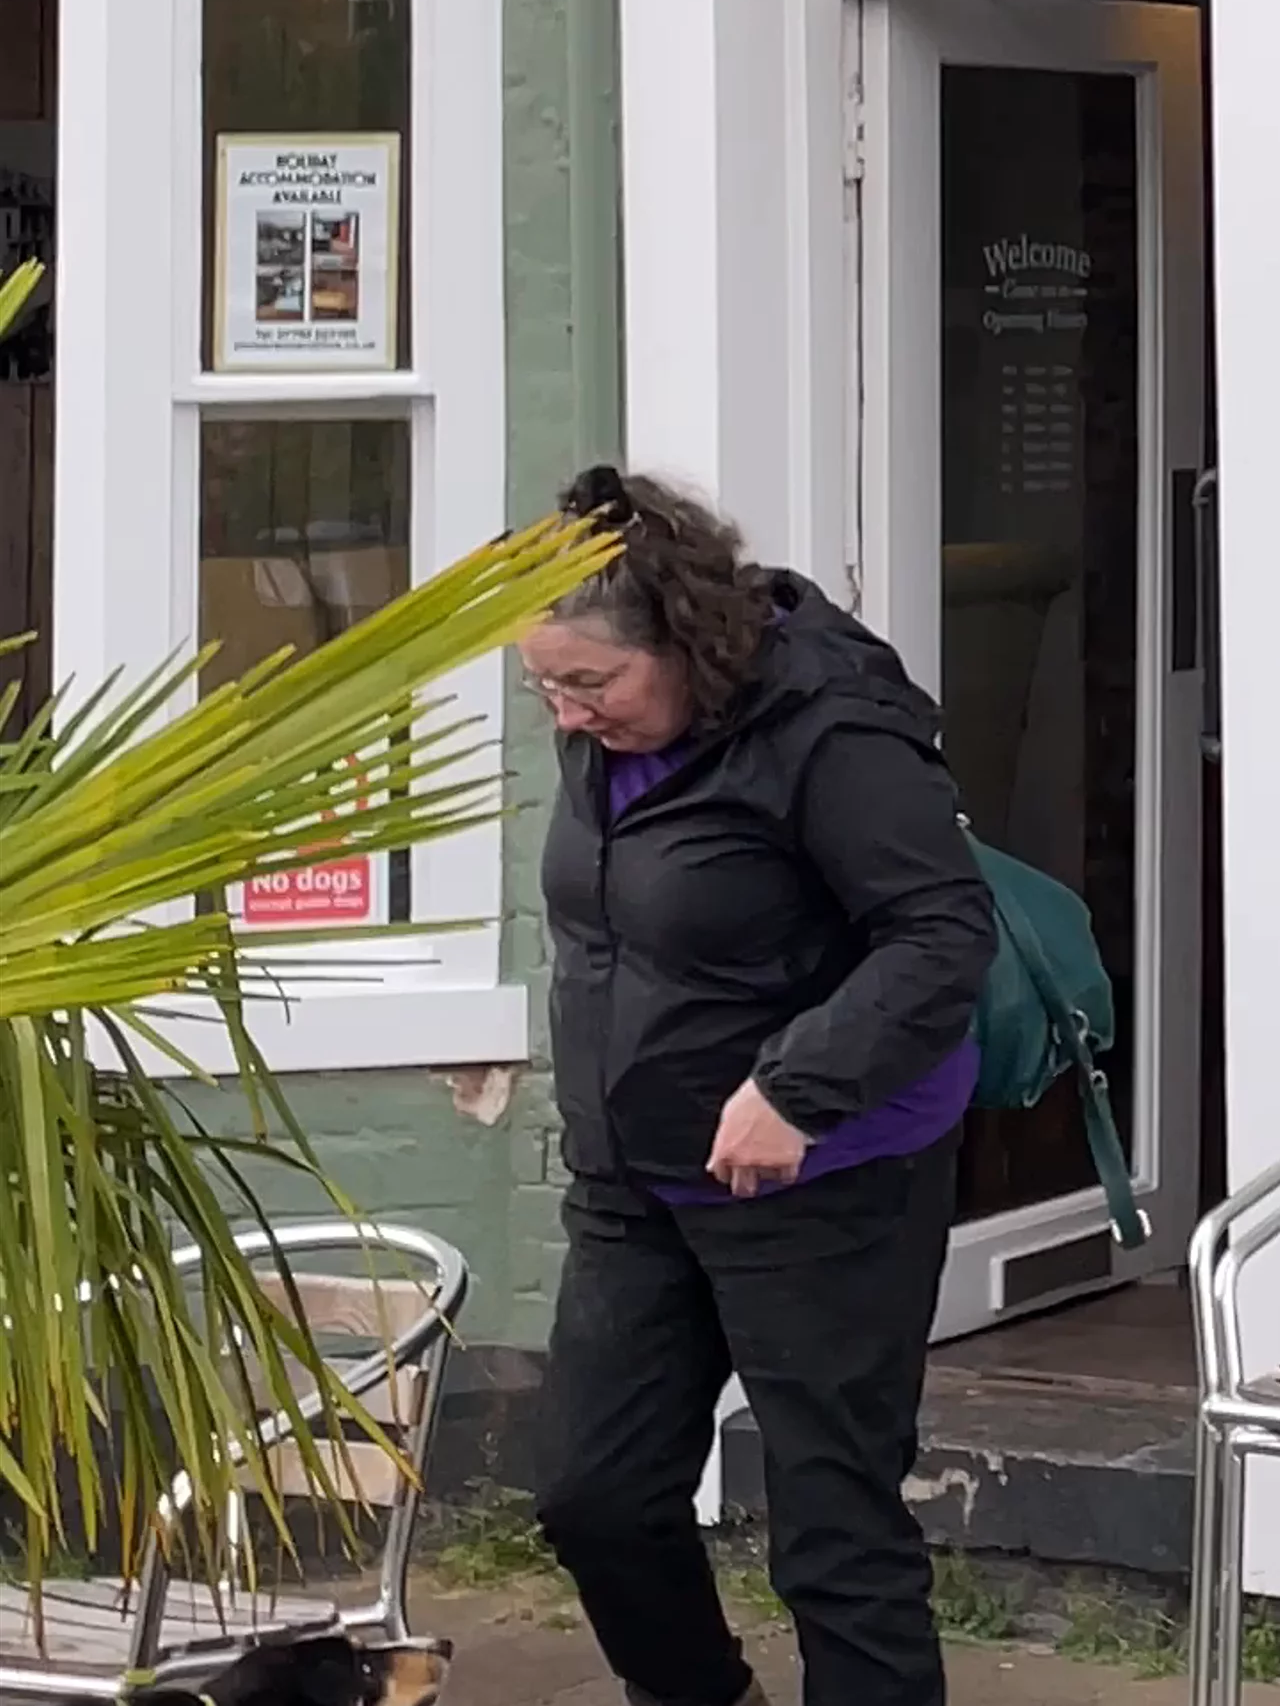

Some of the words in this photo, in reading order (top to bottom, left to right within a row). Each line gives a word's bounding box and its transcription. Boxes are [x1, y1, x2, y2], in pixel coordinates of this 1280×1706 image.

[276, 154, 337, 169] HOLIDAY
[240, 171, 376, 186] ACCOMMODATION
[273, 190, 341, 204] AVAILABLE
[983, 233, 1091, 279] Welcome
[297, 867, 362, 894] dogs
